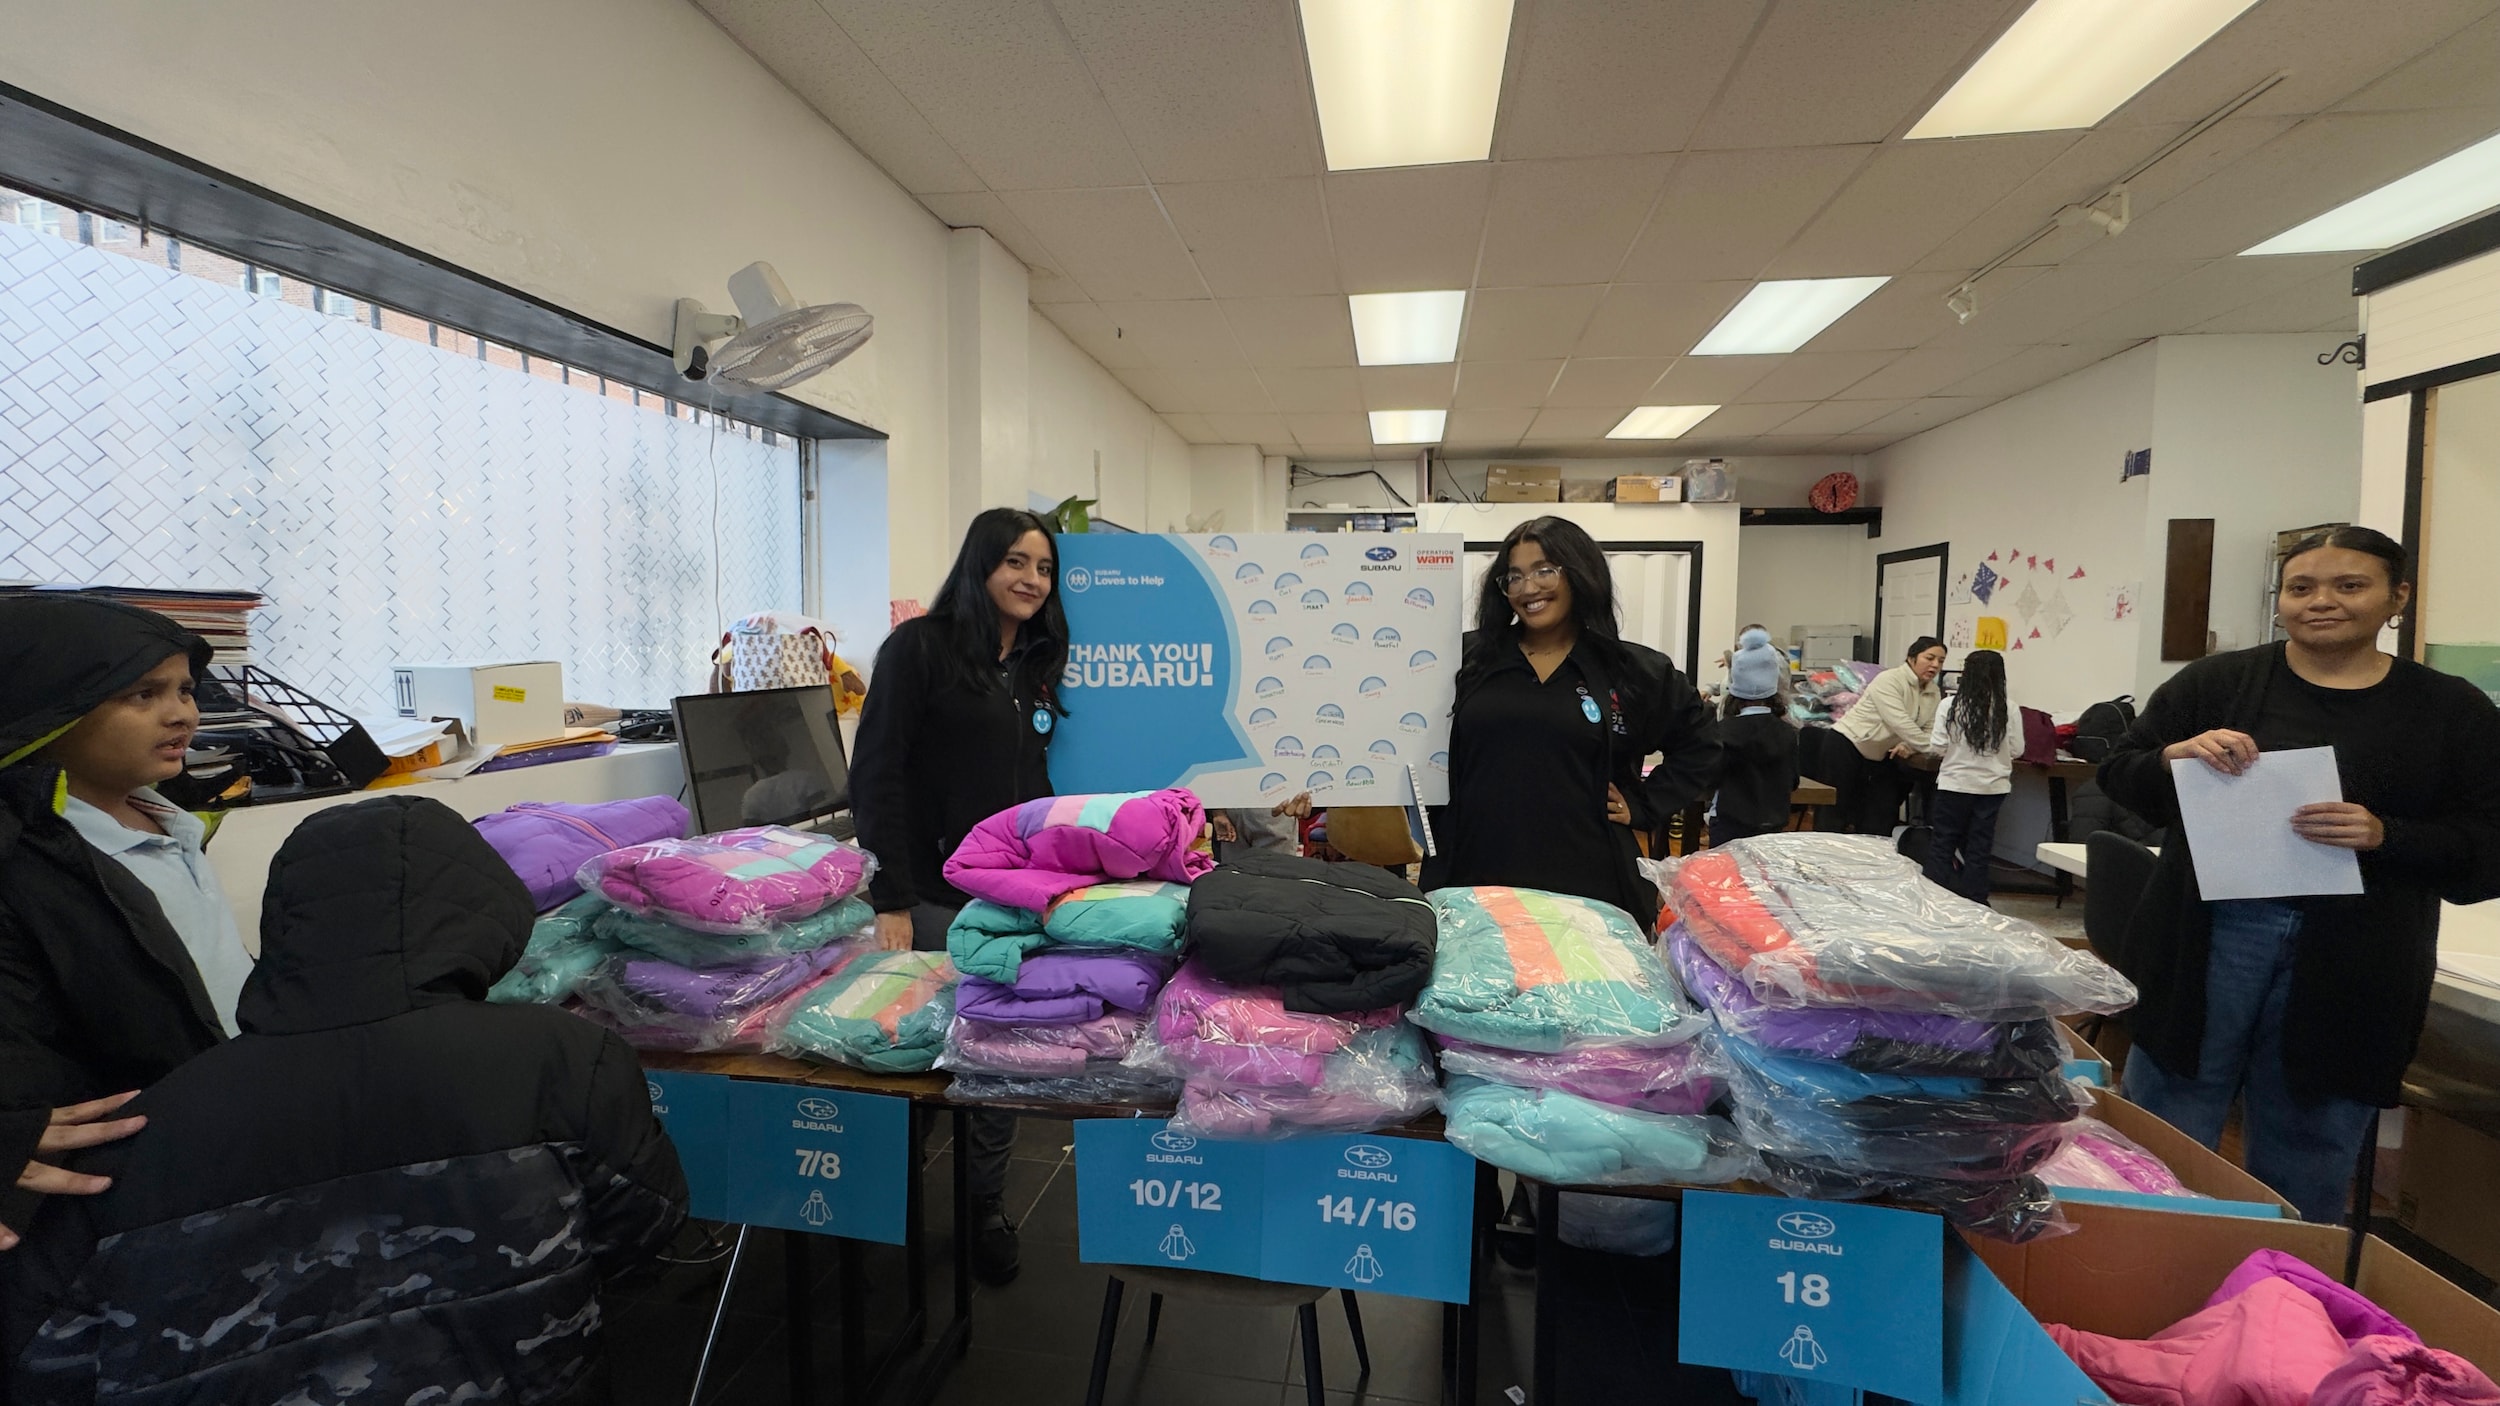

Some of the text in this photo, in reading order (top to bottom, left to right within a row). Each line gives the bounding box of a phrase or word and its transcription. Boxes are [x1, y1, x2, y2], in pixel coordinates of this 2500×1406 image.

[1360, 564, 1402, 572] SUBARU
[1416, 556, 1454, 564] warm
[1095, 576, 1165, 587] Loves to Help
[1149, 644, 1198, 662] YOU
[792, 1119, 844, 1134] SUBARU
[795, 1148, 841, 1180] 7/8
[1146, 1153, 1203, 1165] SUBARU
[1337, 1168, 1398, 1183] SUBARU
[1129, 1179, 1222, 1211] 10/12
[1317, 1194, 1417, 1232] 14/16
[1768, 1238, 1843, 1256] SUBARU
[1776, 1271, 1831, 1307] 18
